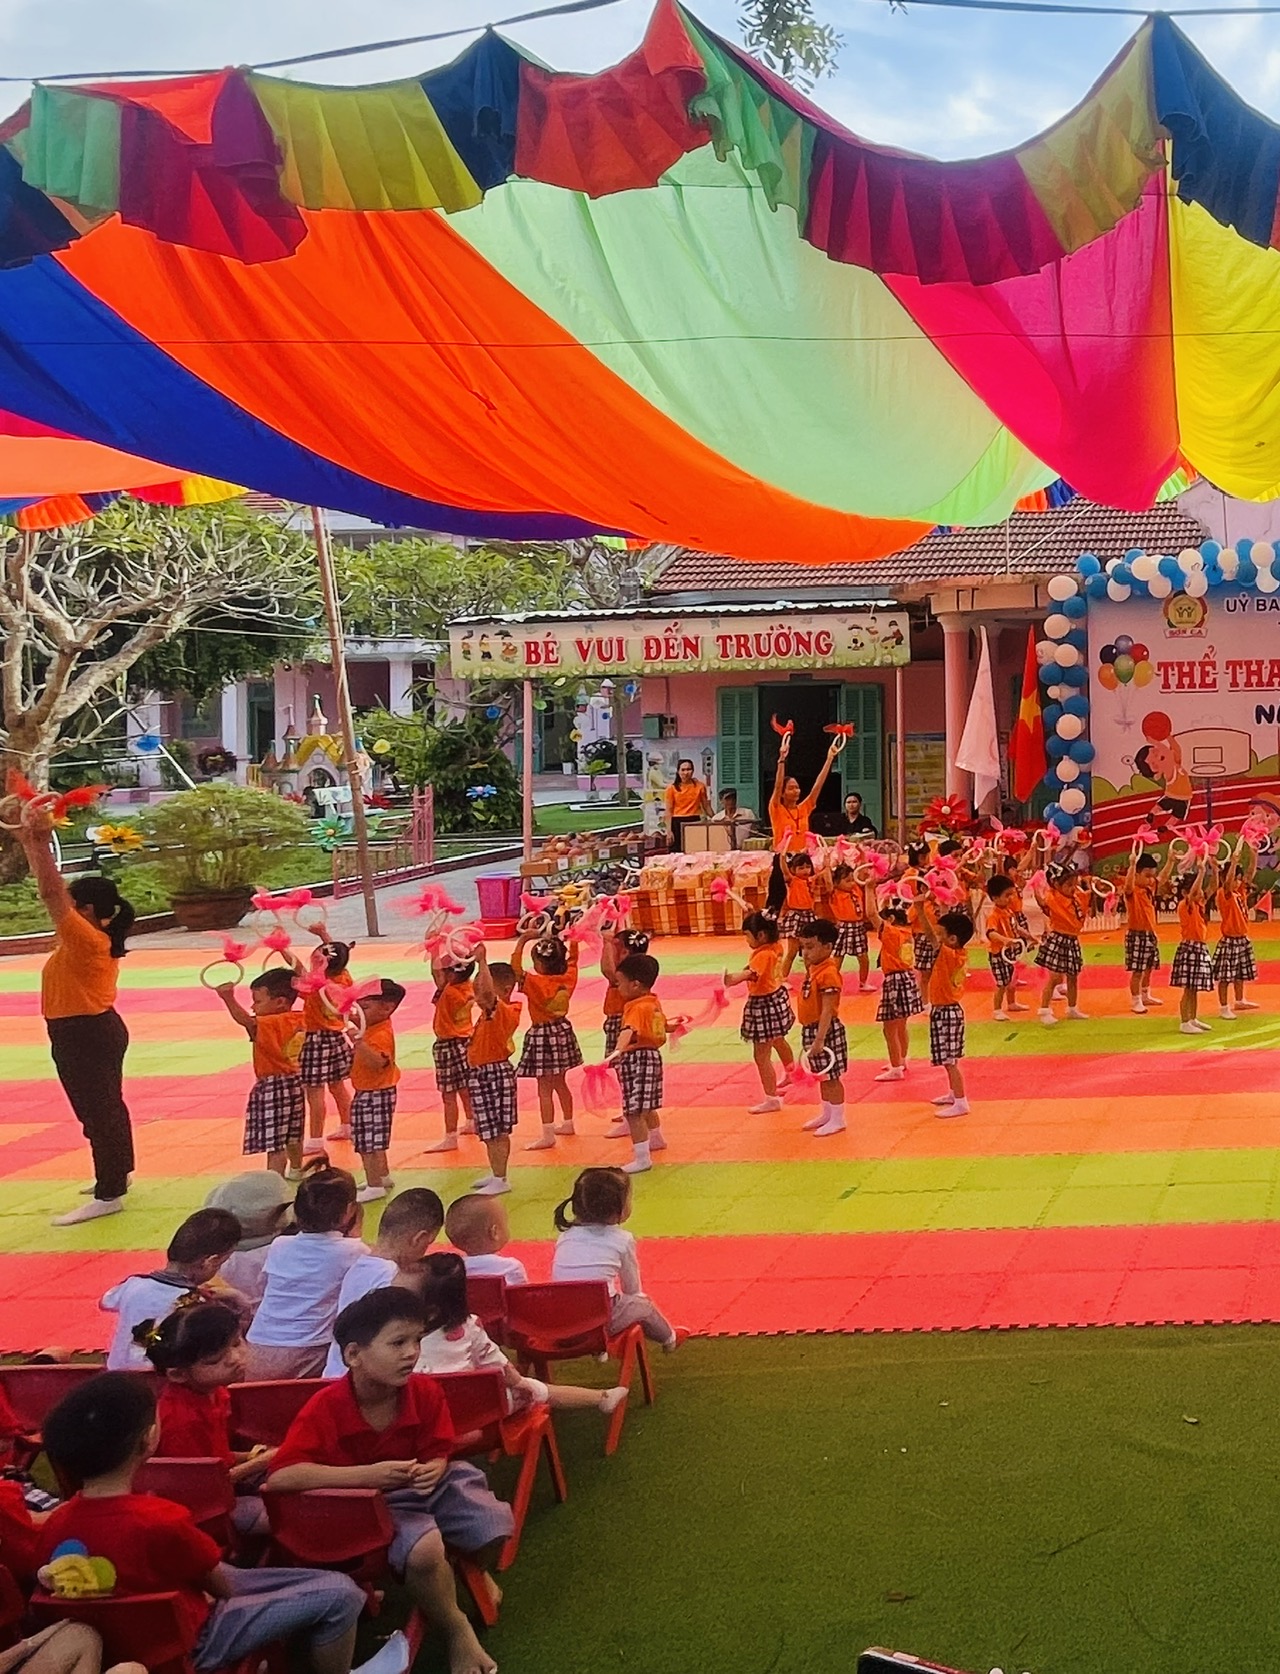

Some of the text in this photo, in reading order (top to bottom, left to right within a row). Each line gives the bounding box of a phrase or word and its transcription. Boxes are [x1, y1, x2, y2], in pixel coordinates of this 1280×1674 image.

[1225, 593, 1249, 613] UỶ
[524, 621, 833, 665] BÉ VUI ĐẾN TRƯỜNG
[1156, 645, 1218, 692] THỂ
